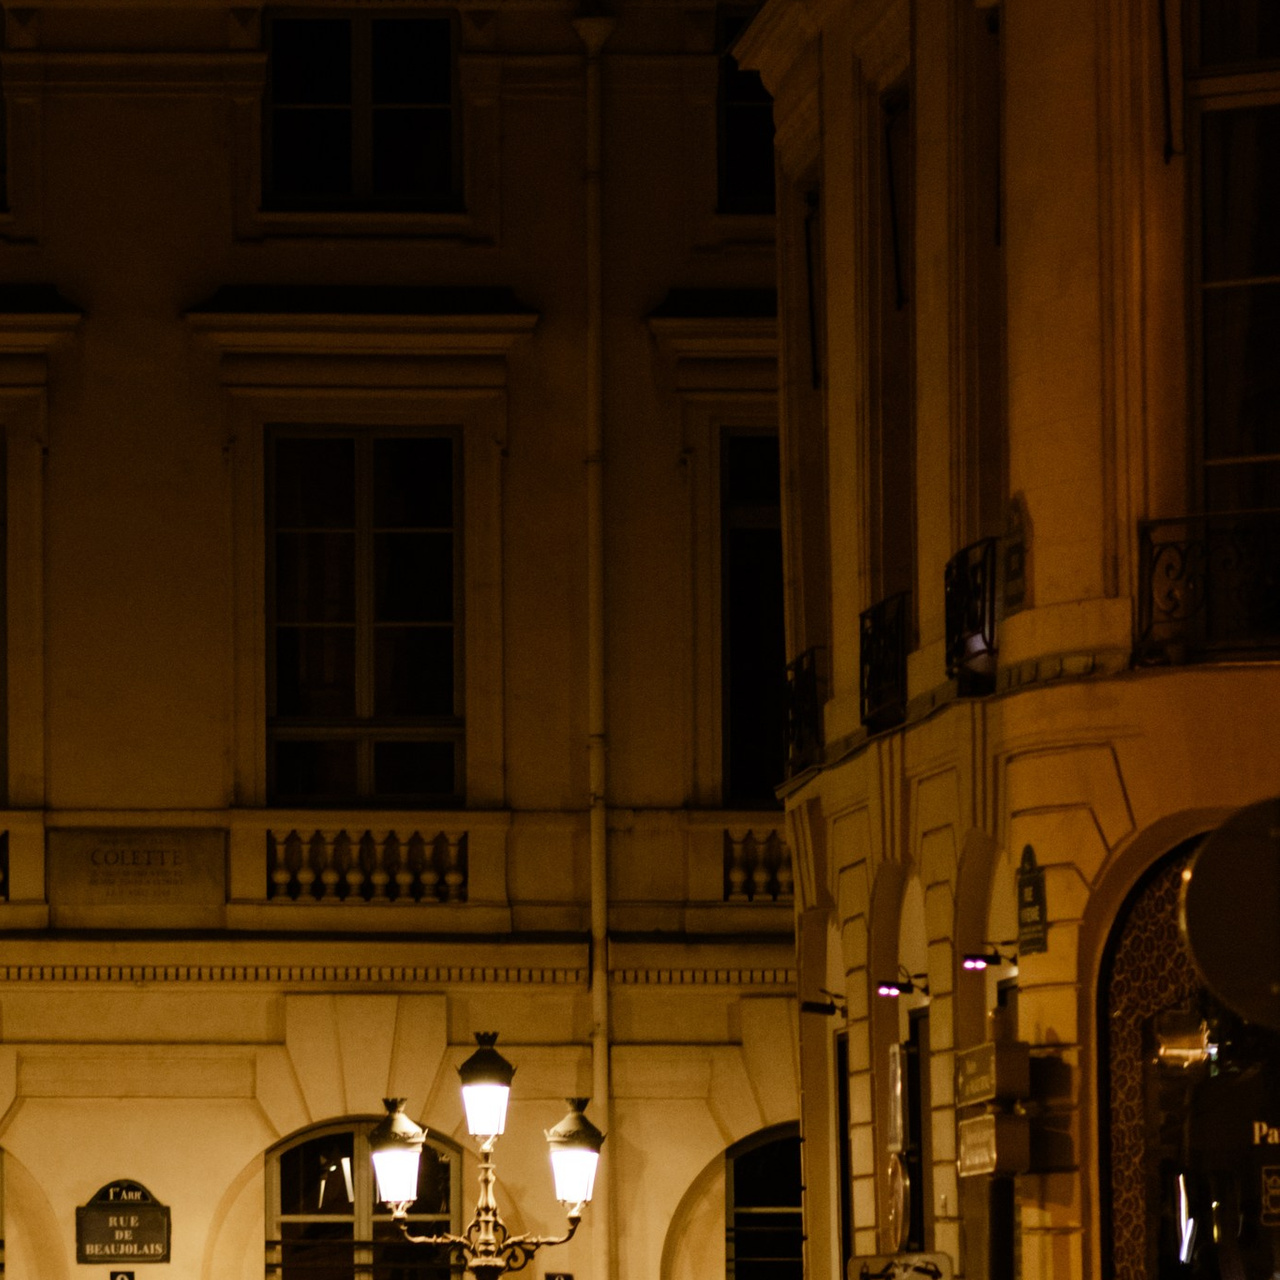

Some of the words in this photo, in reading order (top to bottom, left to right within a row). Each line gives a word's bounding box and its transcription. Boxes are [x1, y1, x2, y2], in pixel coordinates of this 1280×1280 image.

[90, 848, 182, 867] COLETTE
[108, 1216, 140, 1227] RUE
[114, 1230, 133, 1240] DE
[84, 1243, 164, 1255] BEAUJOLAIS
